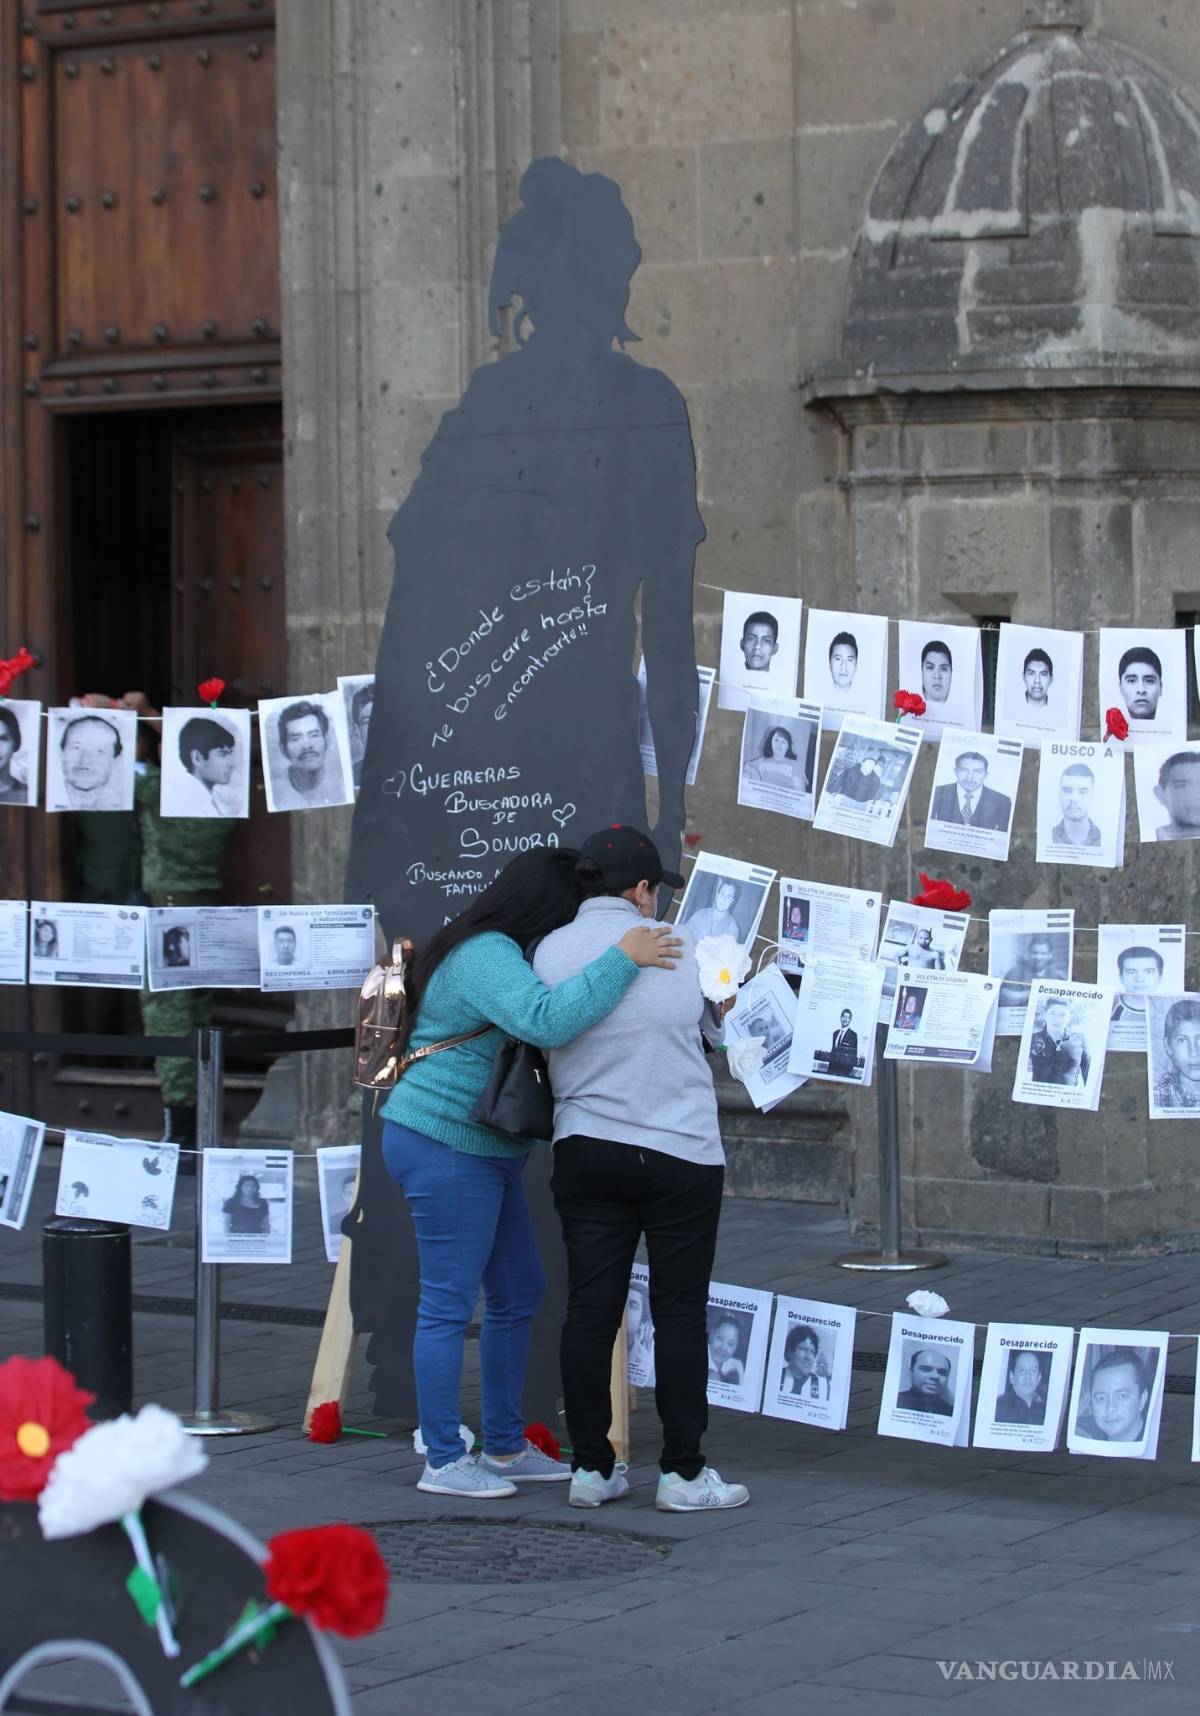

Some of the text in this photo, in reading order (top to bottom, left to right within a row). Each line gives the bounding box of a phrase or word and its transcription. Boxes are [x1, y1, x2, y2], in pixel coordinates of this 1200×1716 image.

[426, 606, 504, 692] ¿Donde
[446, 628, 530, 713] buscare
[540, 601, 607, 629] hasta
[494, 623, 588, 720] encontrarte!!
[1051, 744, 1113, 758] BUSCO A
[492, 812, 517, 824] DE
[459, 828, 559, 858] SONORA
[406, 862, 483, 885] BUSCANDO
[1038, 985, 1103, 1000] Desaparecido
[787, 1310, 842, 1328] Desaparecido
[901, 1328, 964, 1344] Desaparecido
[1000, 1337, 1058, 1350] Desaparecido
